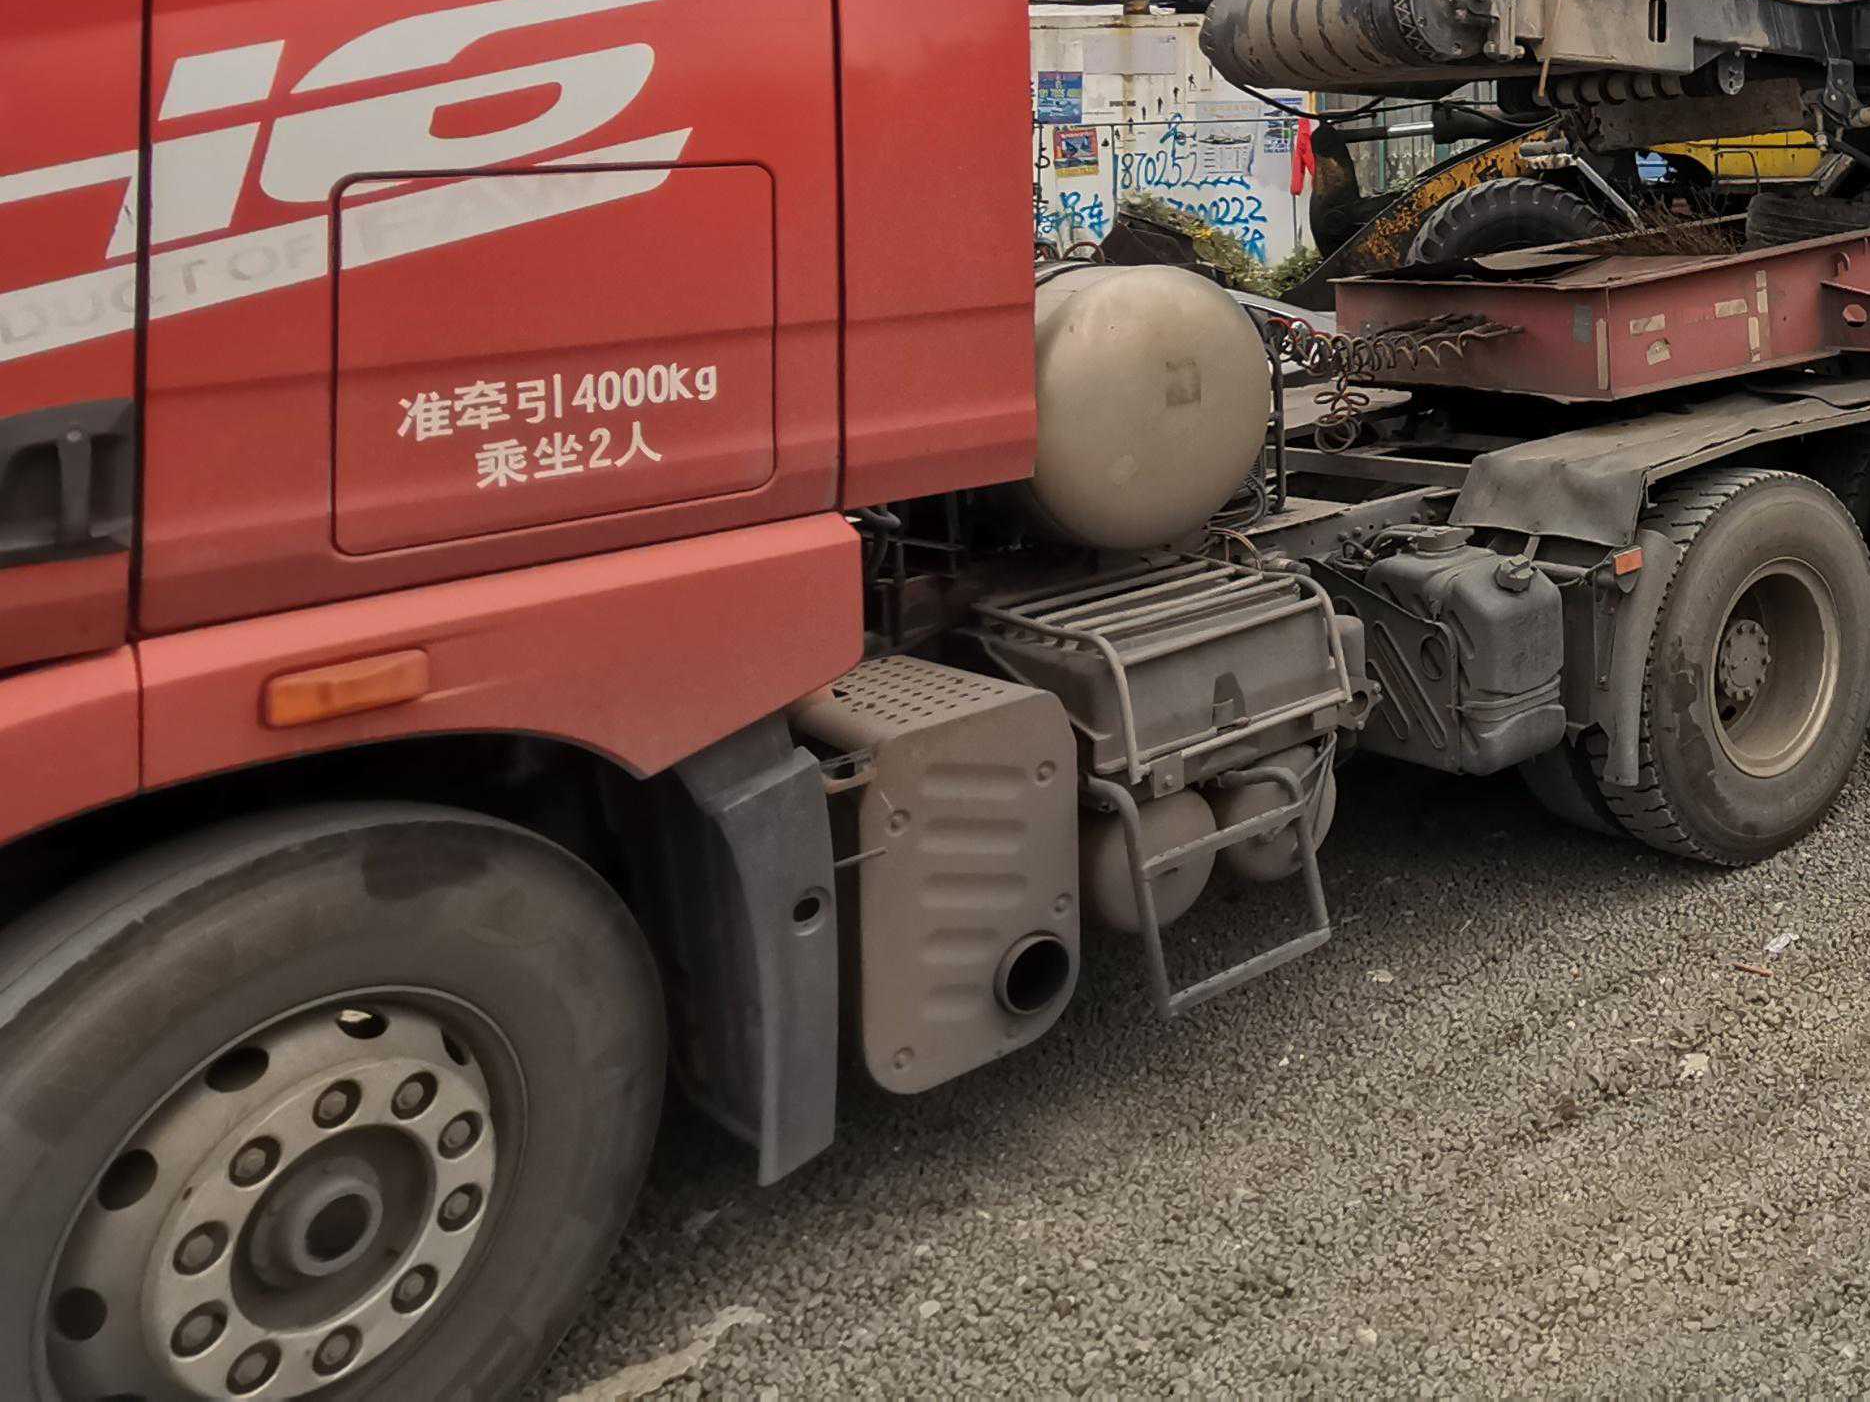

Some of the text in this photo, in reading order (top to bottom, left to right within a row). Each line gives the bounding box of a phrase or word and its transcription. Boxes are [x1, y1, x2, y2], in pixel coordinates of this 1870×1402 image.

[397, 362, 718, 442] 准牵引4000kg
[474, 420, 663, 489] 乘坐2人
